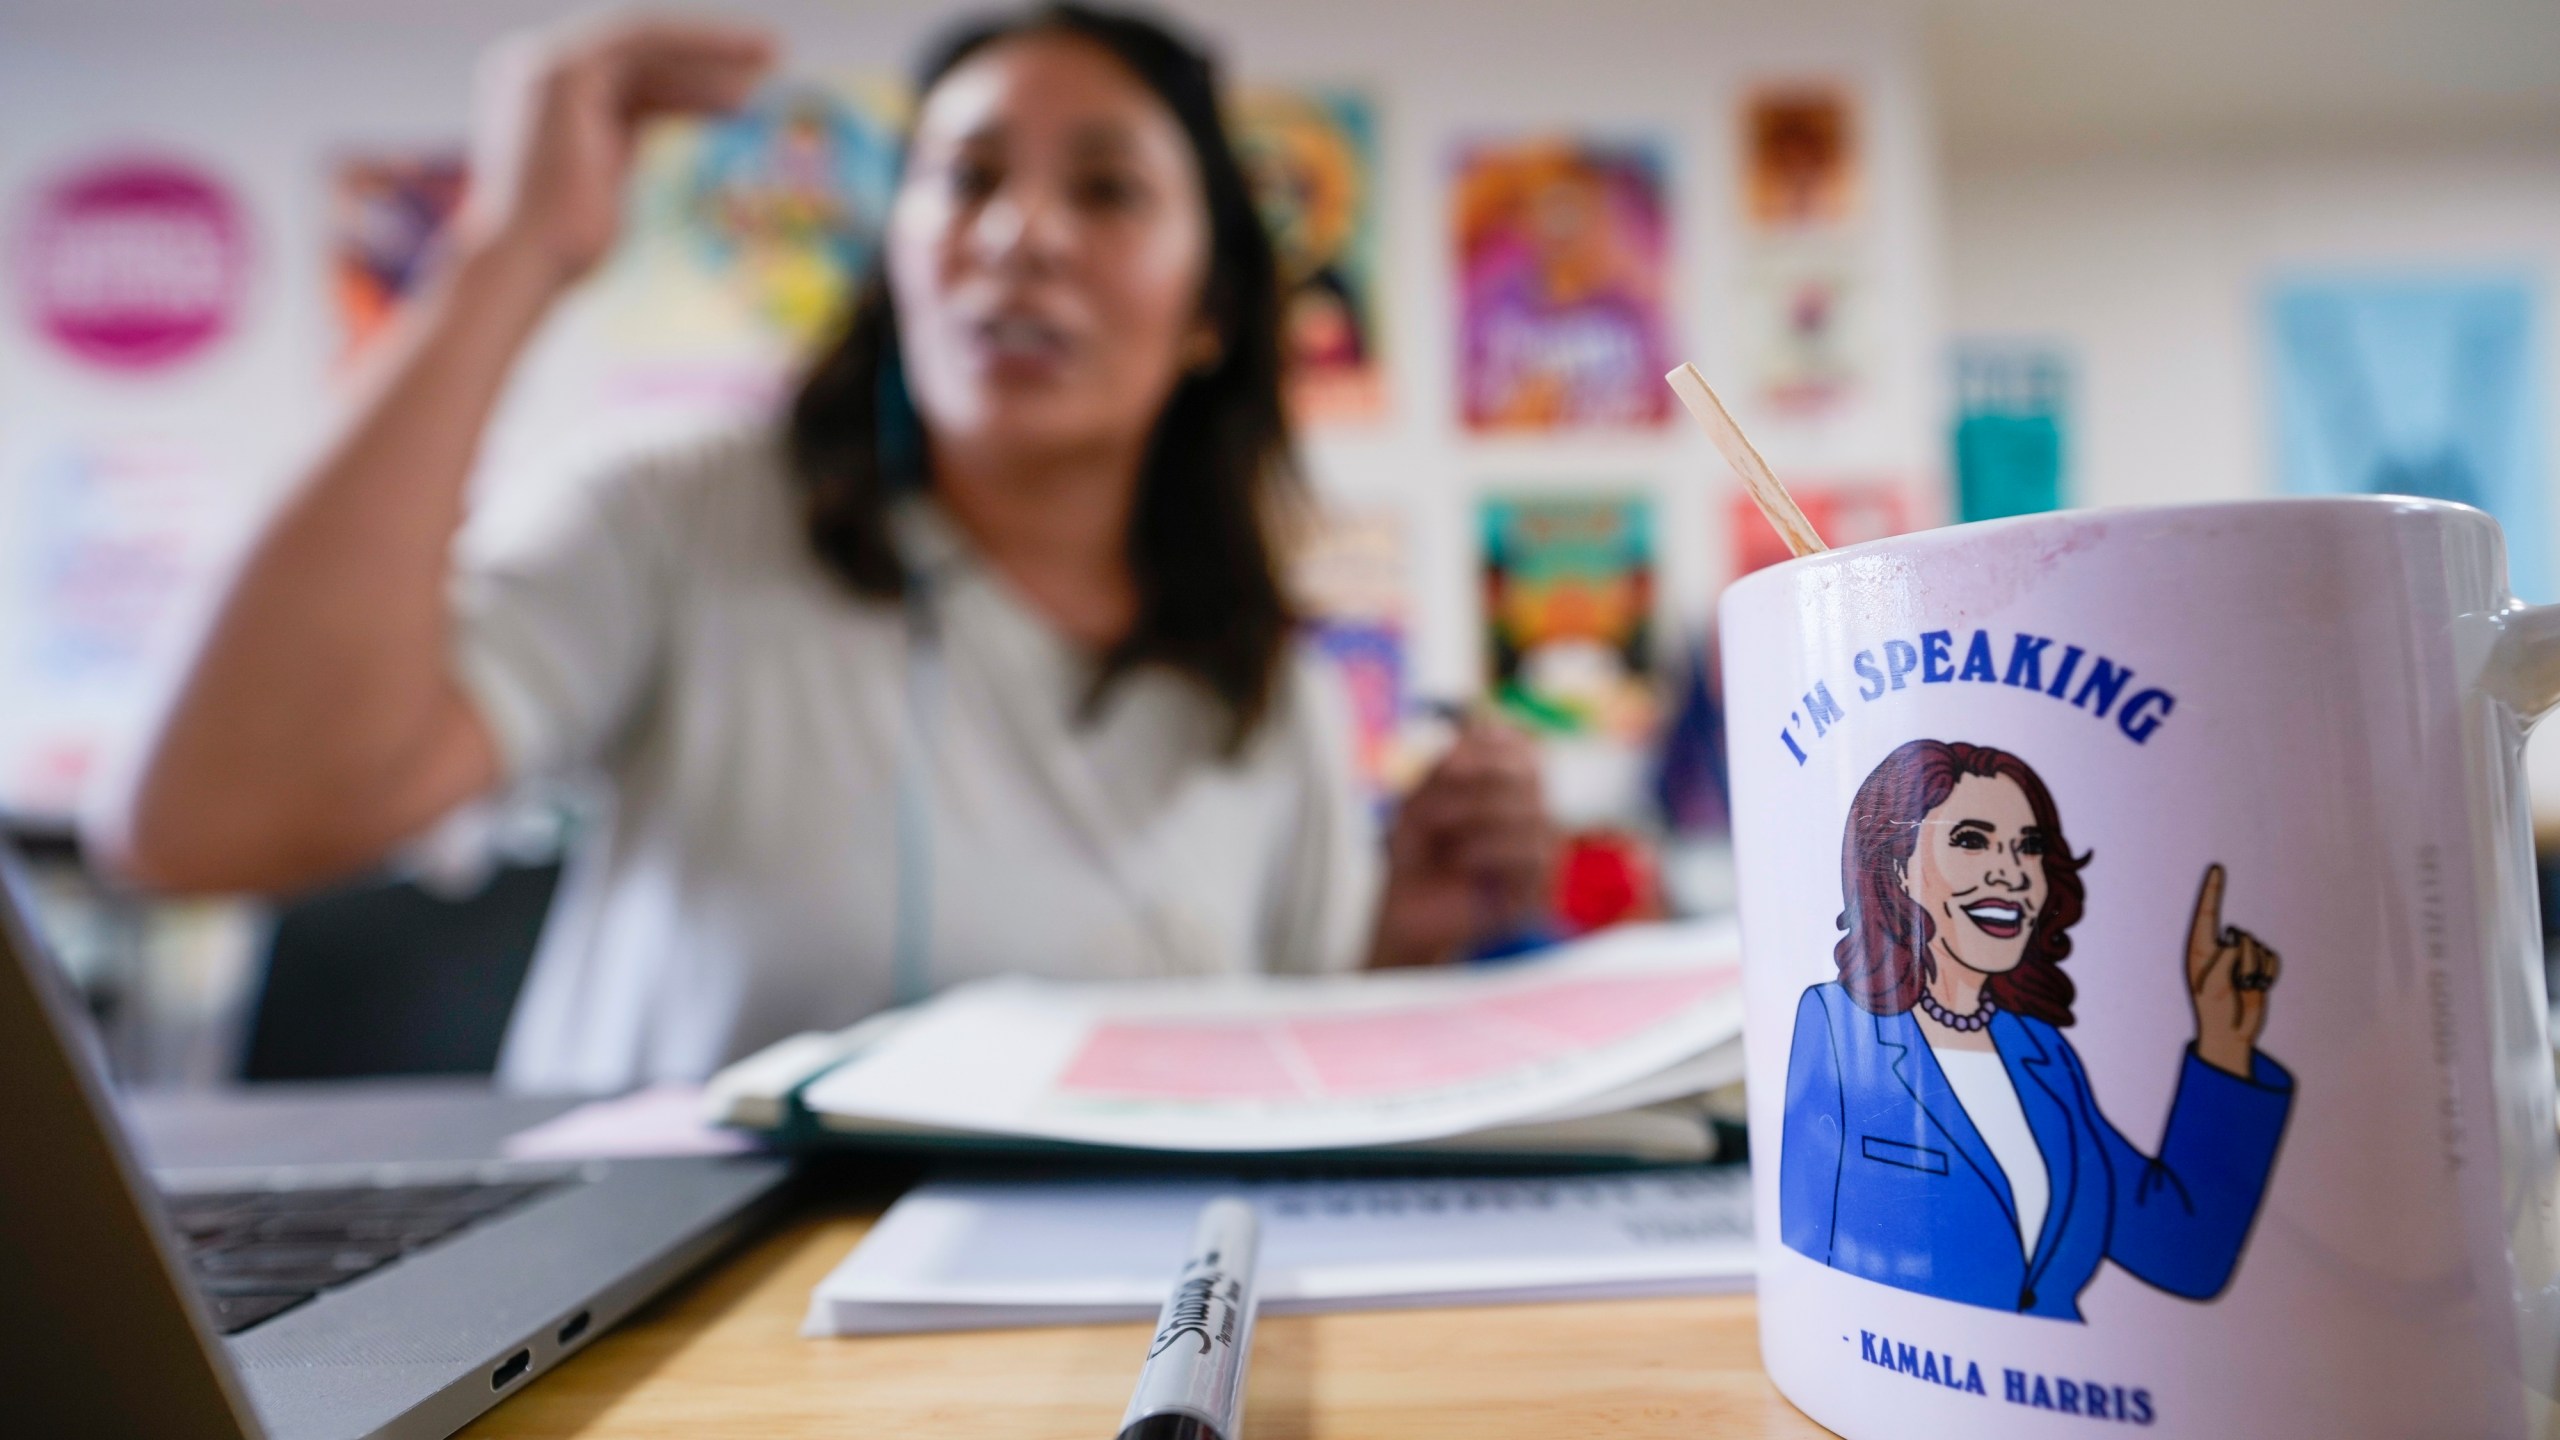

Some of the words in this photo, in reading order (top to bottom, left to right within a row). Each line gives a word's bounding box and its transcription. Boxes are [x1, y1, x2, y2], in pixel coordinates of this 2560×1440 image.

[1780, 679, 1846, 767] I'M
[1853, 628, 2177, 746] SPEAKING
[1860, 1329, 1987, 1396] KAMALA
[2003, 1368, 2157, 1426] HARRIS
